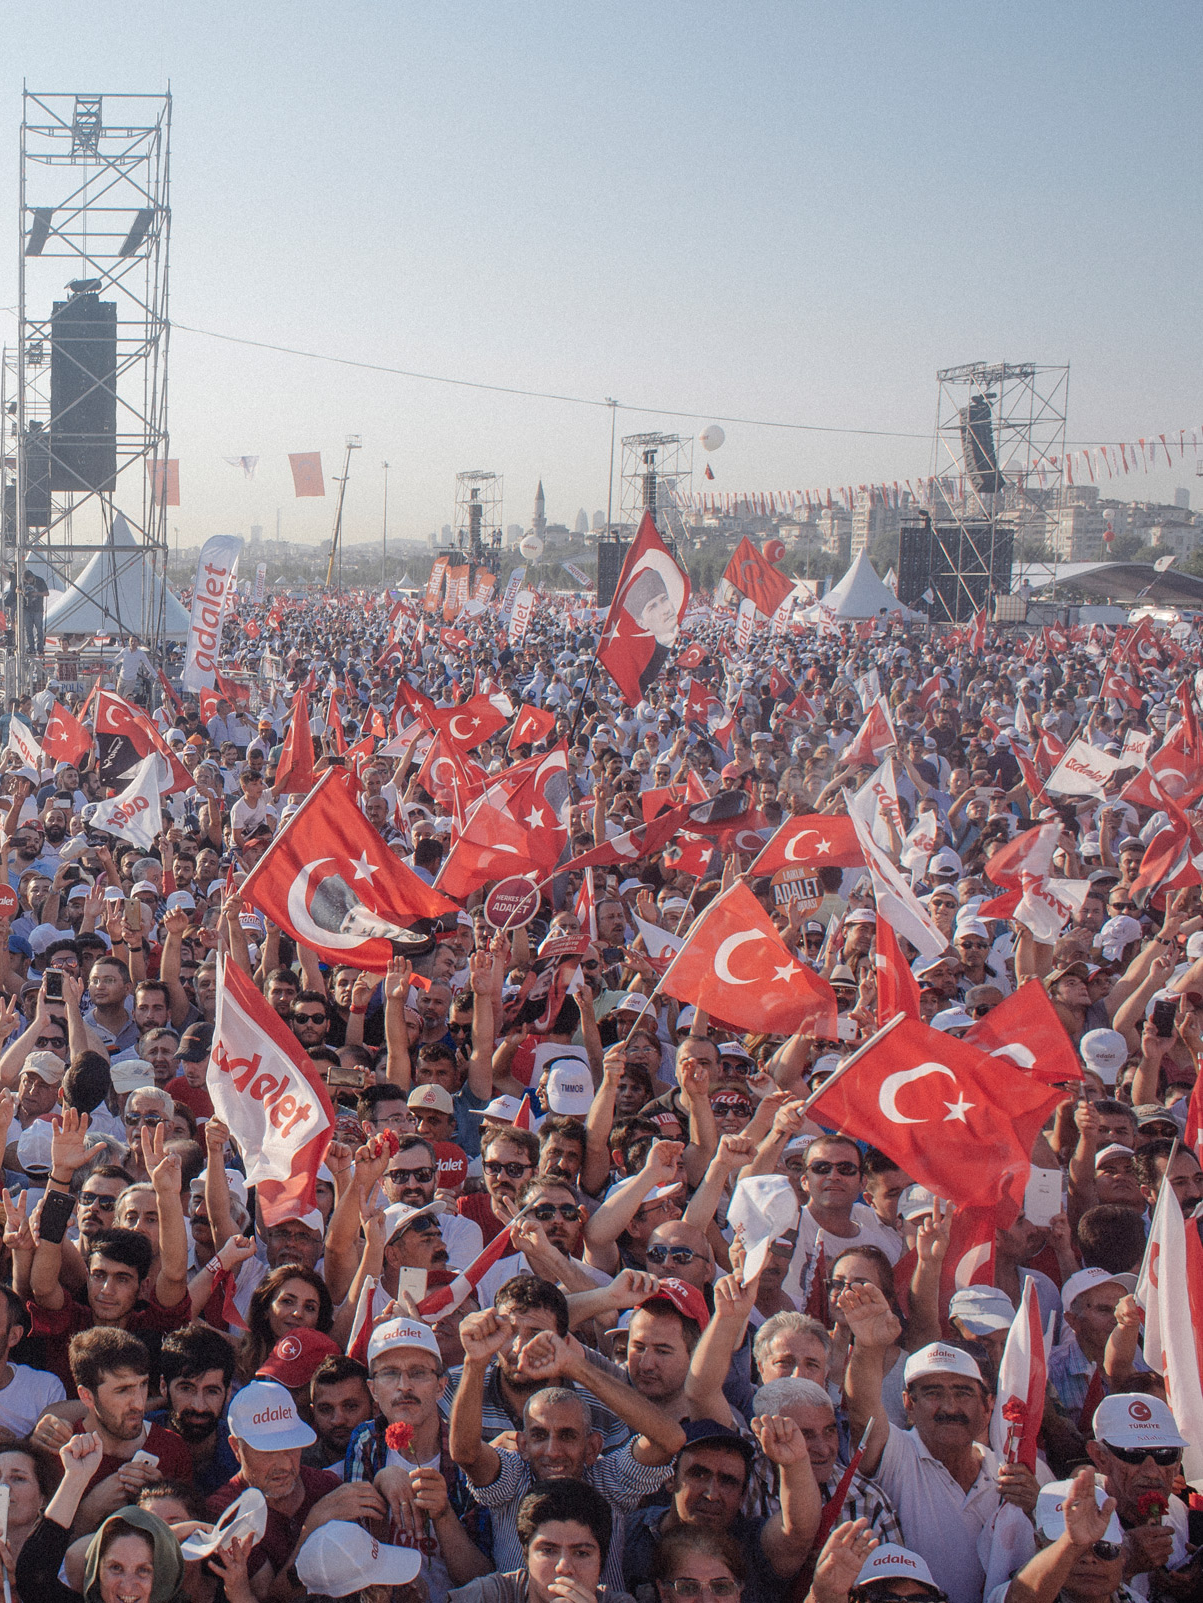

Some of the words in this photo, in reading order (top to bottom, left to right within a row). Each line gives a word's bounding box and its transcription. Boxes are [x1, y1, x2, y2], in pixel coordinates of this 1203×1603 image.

[191, 562, 226, 673] adalet
[774, 877, 819, 905] ADALET
[382, 1328, 422, 1339] adalet
[927, 1350, 957, 1359] adalet
[252, 1405, 293, 1425] adalet
[873, 1553, 918, 1569] adalet
